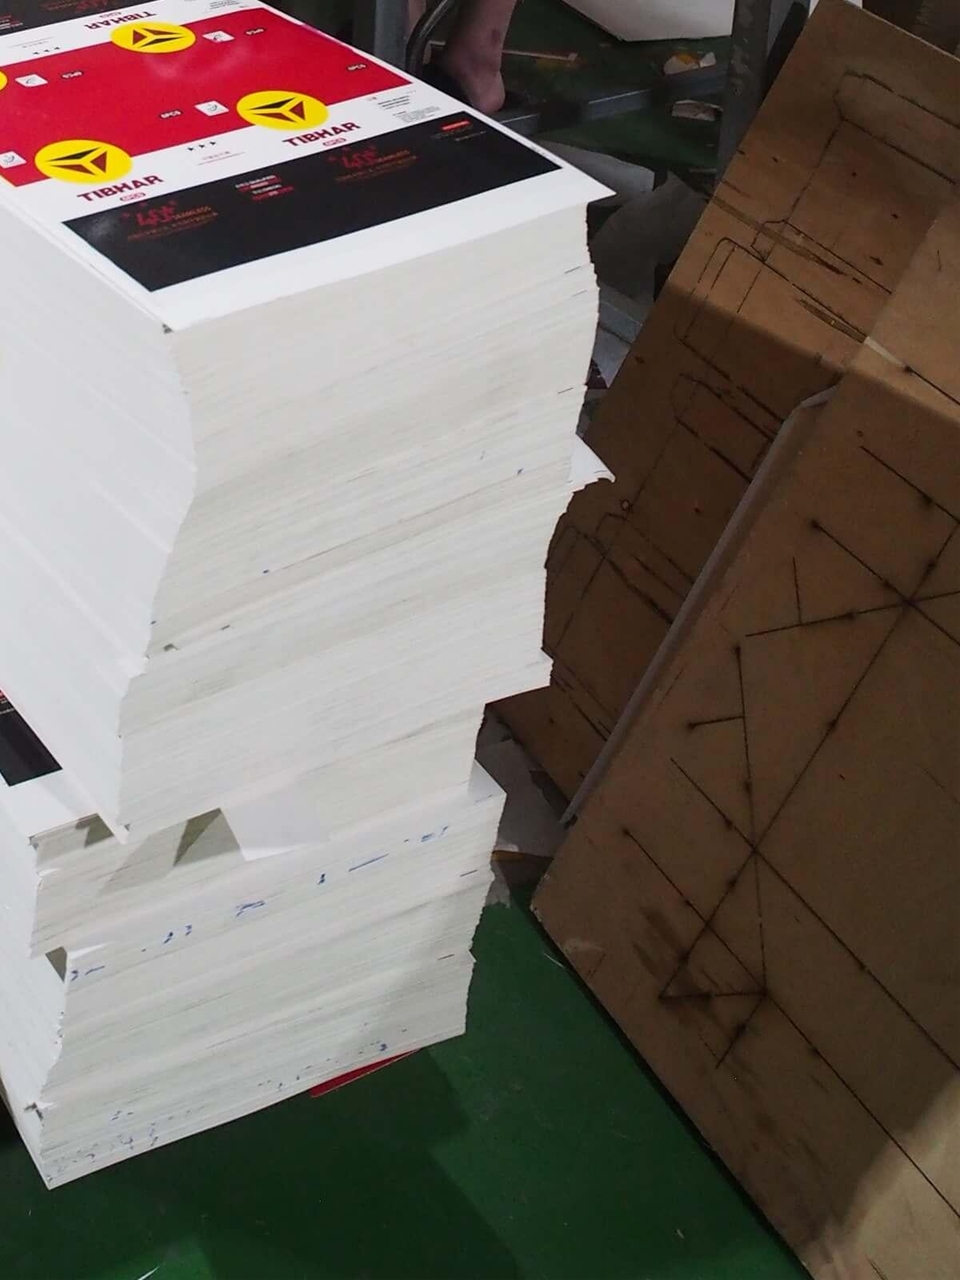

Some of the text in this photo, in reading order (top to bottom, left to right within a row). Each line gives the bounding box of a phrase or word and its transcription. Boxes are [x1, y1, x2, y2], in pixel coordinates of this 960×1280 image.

[83, 11, 157, 30] TIBHAR
[282, 122, 361, 147] TIBHAR
[76, 175, 164, 202] TIBHAR
